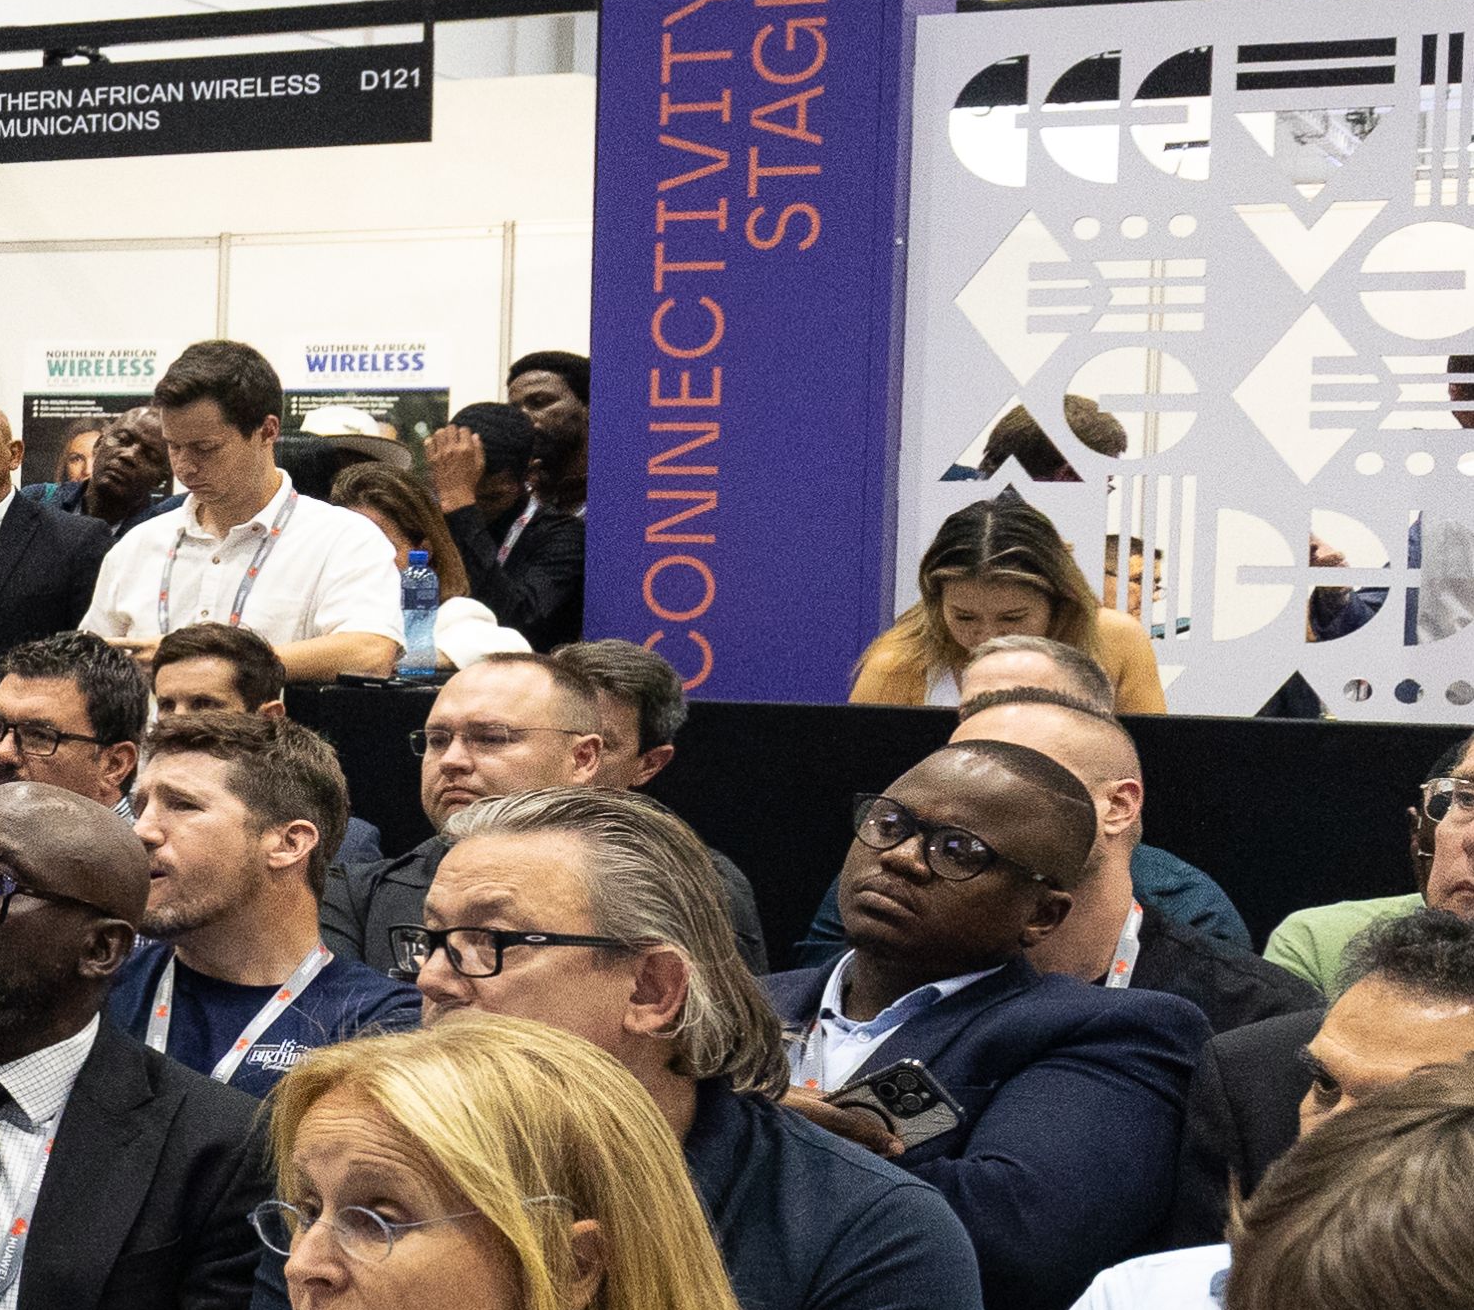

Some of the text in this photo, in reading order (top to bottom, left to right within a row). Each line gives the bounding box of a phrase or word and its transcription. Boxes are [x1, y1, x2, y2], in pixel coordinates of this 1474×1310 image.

[360, 68, 422, 91] D121
[77, 81, 184, 108] AFRICAN
[191, 73, 321, 101] WIRELESS
[46, 349, 157, 358] NORTHERN AFRICAN
[306, 343, 426, 353] SOUTHERN AFRICAN
[47, 358, 156, 377] WIRELESS
[306, 353, 424, 372] WIRELESS
